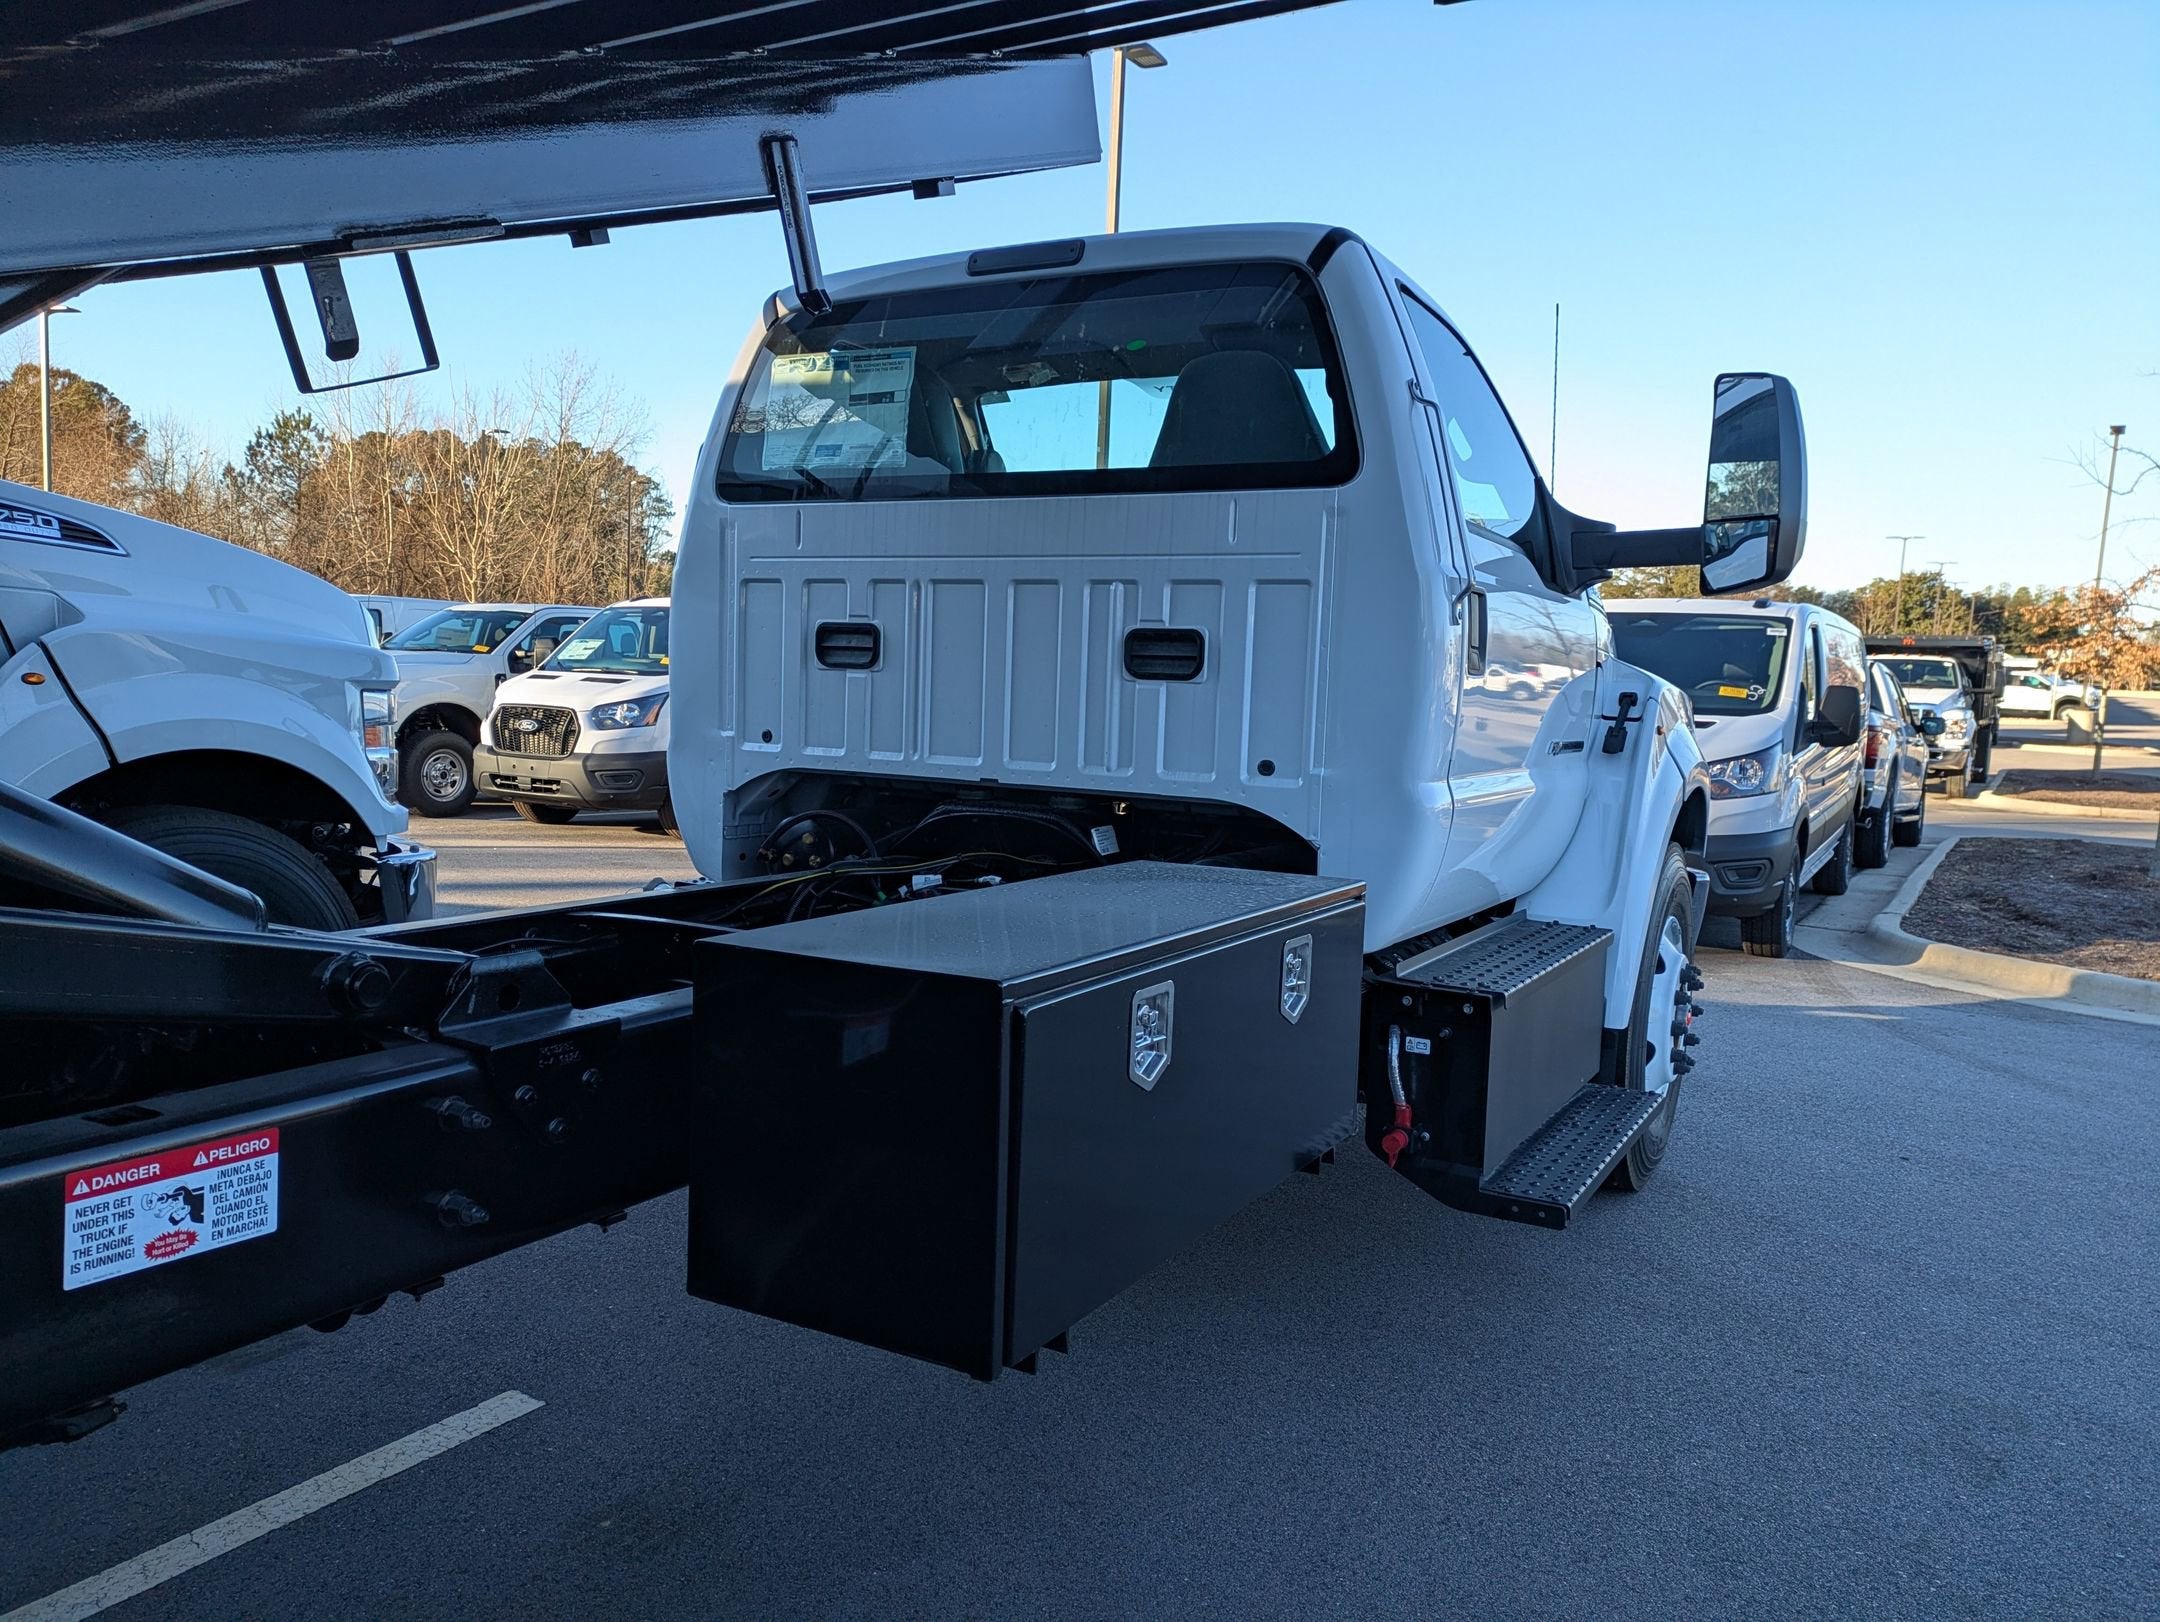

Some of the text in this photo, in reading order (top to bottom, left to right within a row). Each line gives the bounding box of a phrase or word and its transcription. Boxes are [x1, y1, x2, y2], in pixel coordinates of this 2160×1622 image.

[209, 1138, 270, 1162] PELIGRO
[92, 1163, 160, 1190] DANGER
[209, 1170, 272, 1194] META DEBAJO
[216, 1160, 266, 1180] ¡NUNCA SE
[212, 1181, 268, 1205] DEL CAMIÓN
[215, 1194, 266, 1216] CUANDO EL
[75, 1196, 133, 1219] NEVER GET
[212, 1204, 269, 1229] MOTOR ESTÉ
[72, 1209, 135, 1233] UNDER THIS
[211, 1229, 225, 1241] EN
[230, 1216, 268, 1237] MARCHA!
[80, 1223, 128, 1245] TRUCK IF
[166, 1236, 178, 1244] May
[72, 1235, 134, 1261] THE ENGINE
[151, 1247, 165, 1256] Hurt
[172, 1240, 189, 1250] Killed
[70, 1248, 135, 1275] IS RUNNING!
